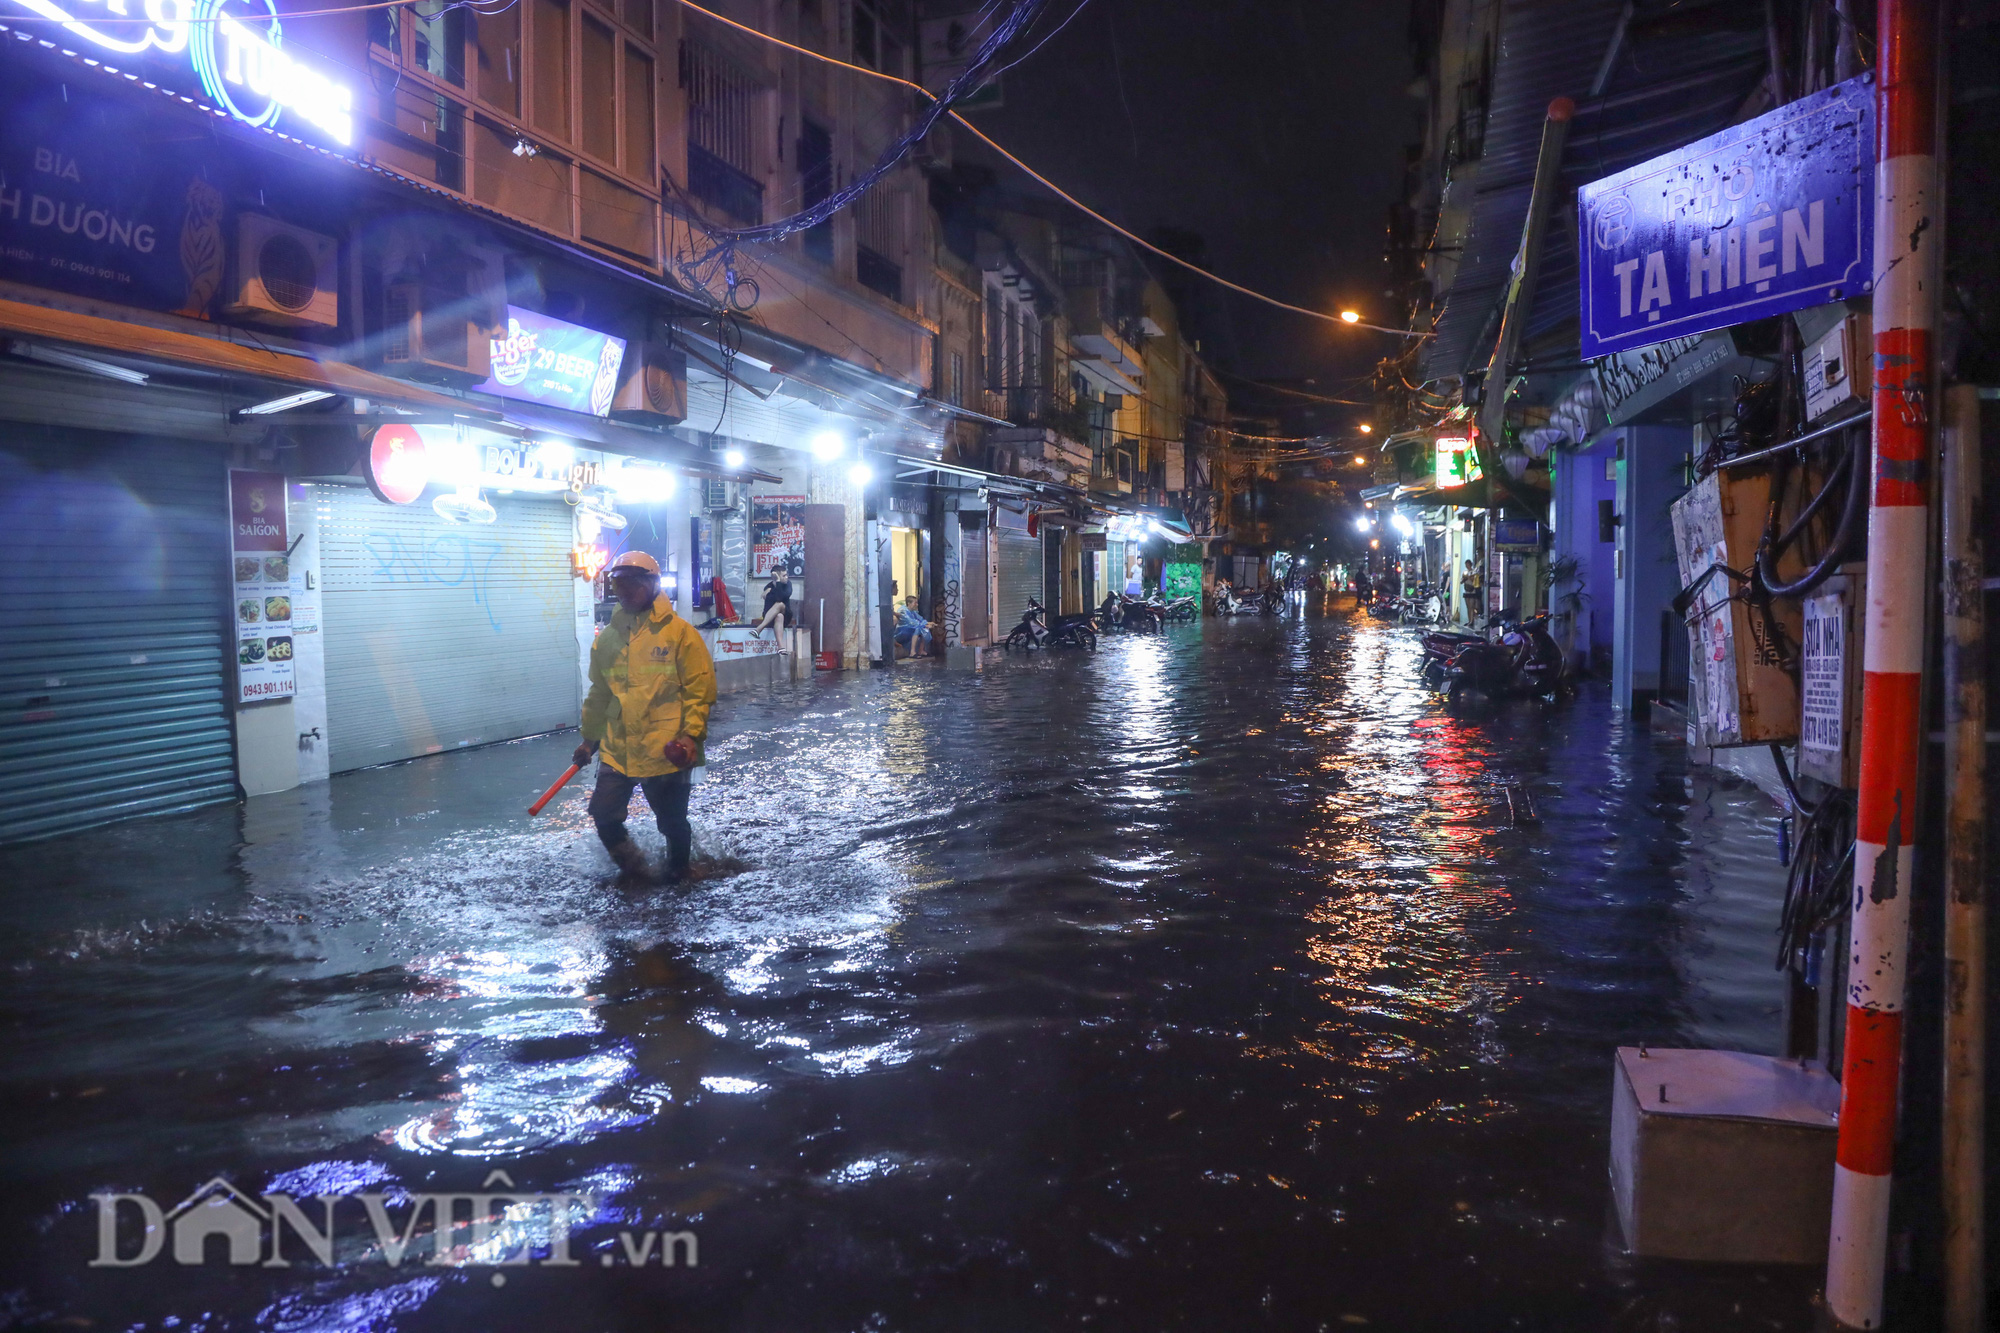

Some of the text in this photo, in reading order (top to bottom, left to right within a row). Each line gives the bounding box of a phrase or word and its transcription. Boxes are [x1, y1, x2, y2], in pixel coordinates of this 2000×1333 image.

[35, 147, 81, 183] BIA
[1666, 146, 1755, 224] PHỐ
[30, 194, 156, 253] DƯƠNG
[70, 261, 95, 275] 0943
[98, 268, 115, 279] 901
[117, 272, 131, 283] 114
[1613, 199, 1825, 322] TẠ HIỆN
[535, 347, 555, 371] 29
[554, 352, 597, 381] BEER
[486, 446, 537, 479] BOLD
[239, 524, 279, 536] SAIGON
[252, 517, 265, 525] BIA
[782, 523, 801, 533] Soul
[573, 545, 608, 577] Tiger
[761, 555, 779, 563] 5TH
[1823, 607, 1840, 656] NHÀ
[243, 680, 293, 697] 0943.901.114
